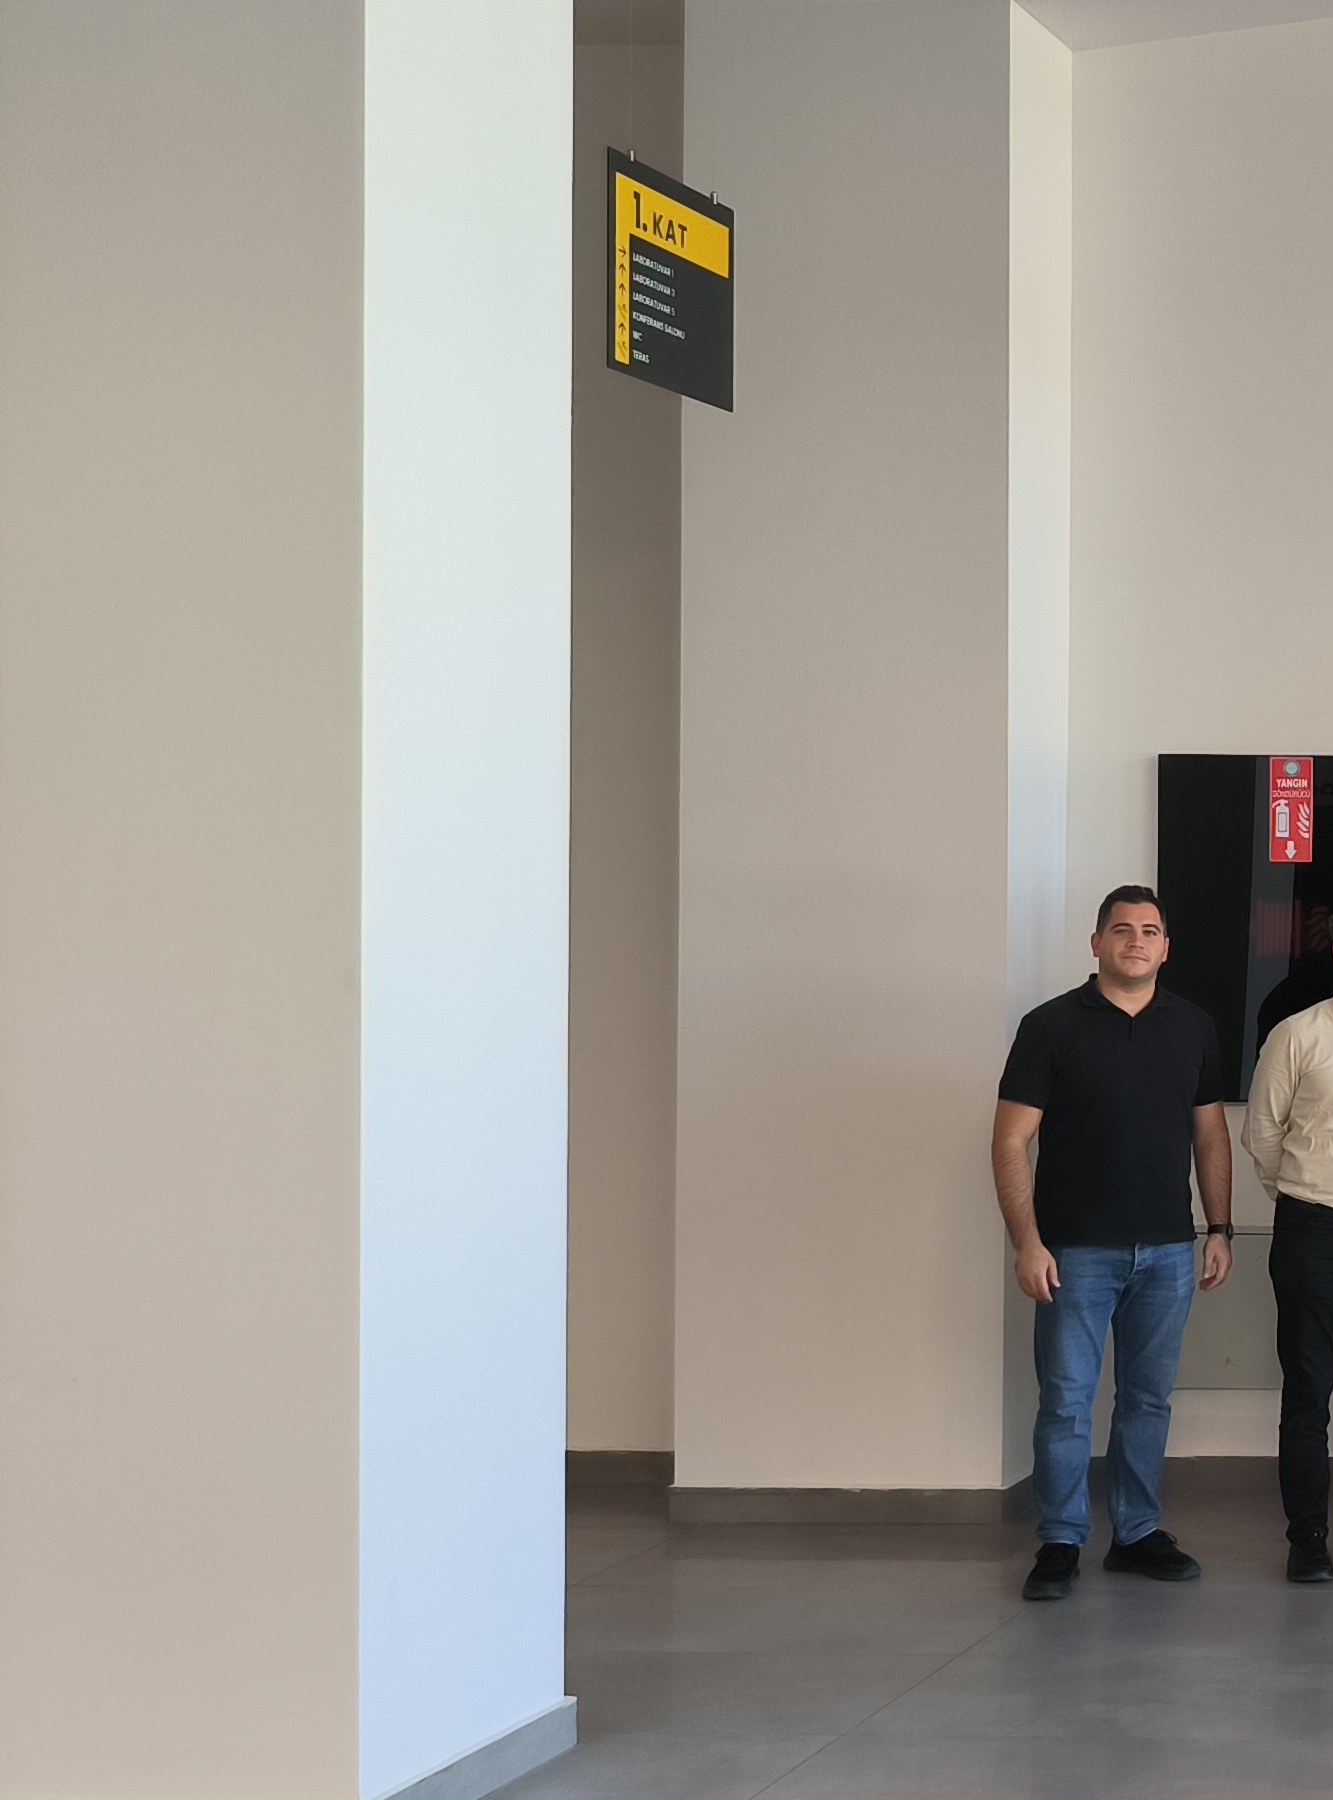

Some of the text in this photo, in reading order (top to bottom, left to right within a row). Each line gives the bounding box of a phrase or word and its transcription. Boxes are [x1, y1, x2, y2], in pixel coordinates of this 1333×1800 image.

[633, 190, 688, 249] 1. KAT
[632, 252, 671, 277] LABORATUVAR
[632, 272, 671, 296] LABORATUVAR
[632, 292, 671, 315] LABORATUVAR
[632, 311, 686, 340] KONFERANS SALONU
[632, 330, 643, 341] WC
[632, 349, 650, 364] TERAS
[1275, 778, 1308, 788] YANGIN
